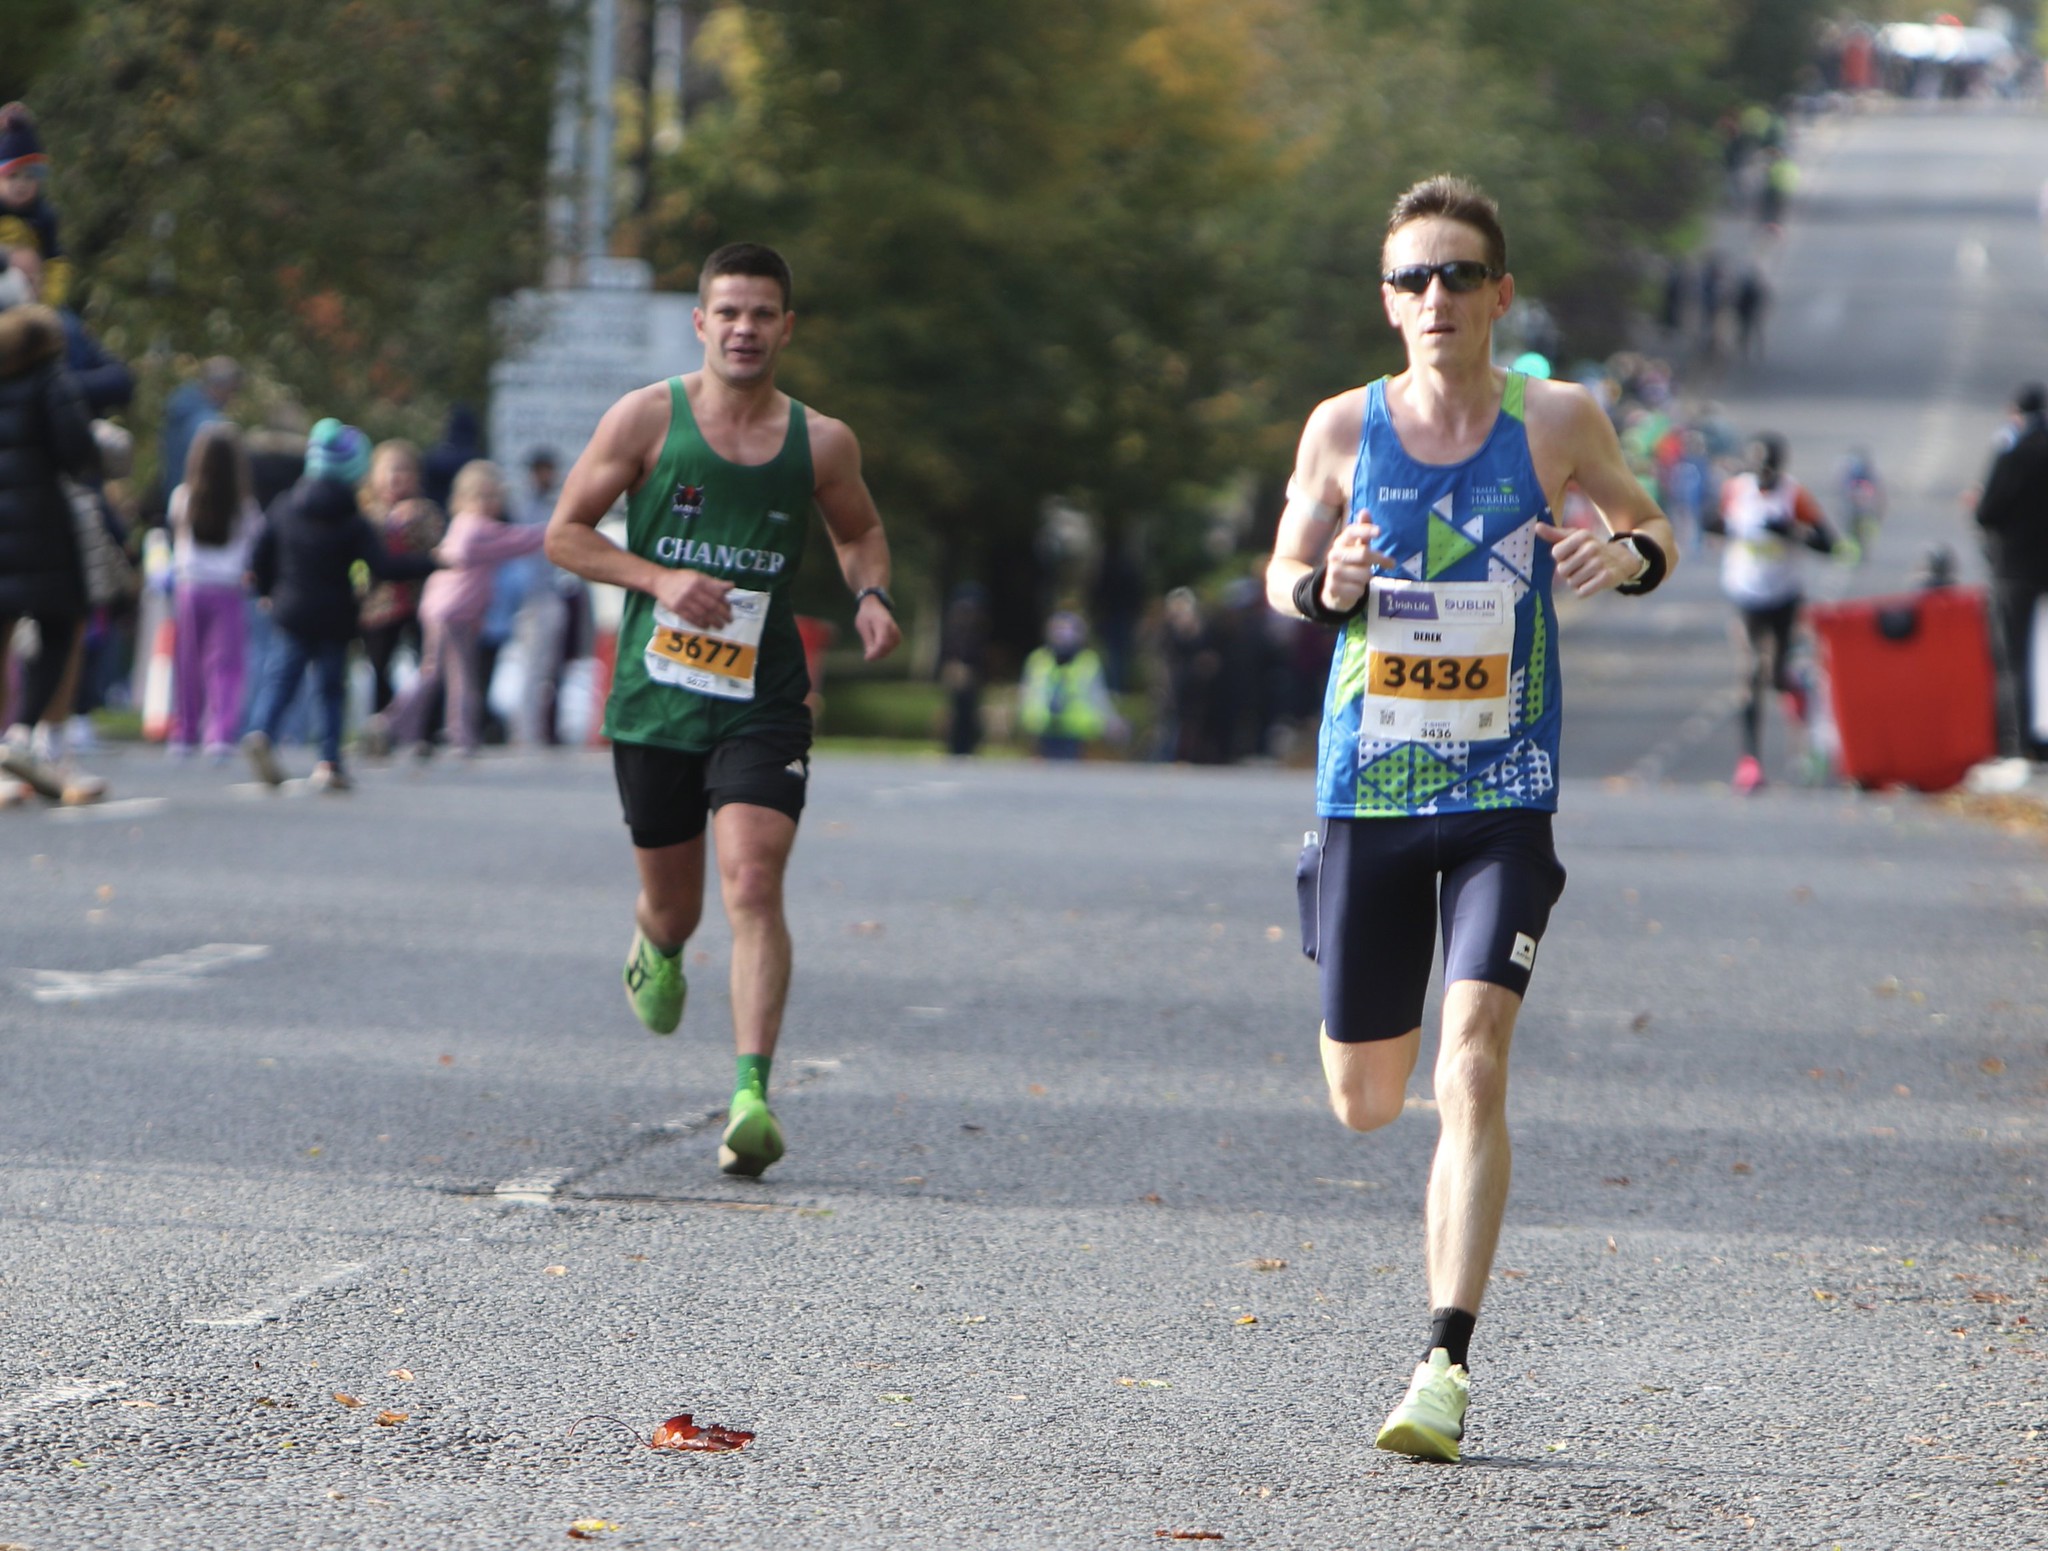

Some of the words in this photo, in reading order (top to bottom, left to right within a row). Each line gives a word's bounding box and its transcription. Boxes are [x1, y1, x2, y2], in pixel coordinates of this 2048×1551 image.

[1471, 494, 1520, 505] HARRIERS
[656, 536, 785, 572] CHANCER
[1395, 601, 1413, 610] Irish
[1414, 601, 1430, 611] Life
[1444, 599, 1496, 610] DUBLIN
[1413, 631, 1442, 642] DEREK
[666, 632, 742, 668] 5677
[1383, 656, 1489, 691] 3436
[1420, 728, 1452, 739] 3436
